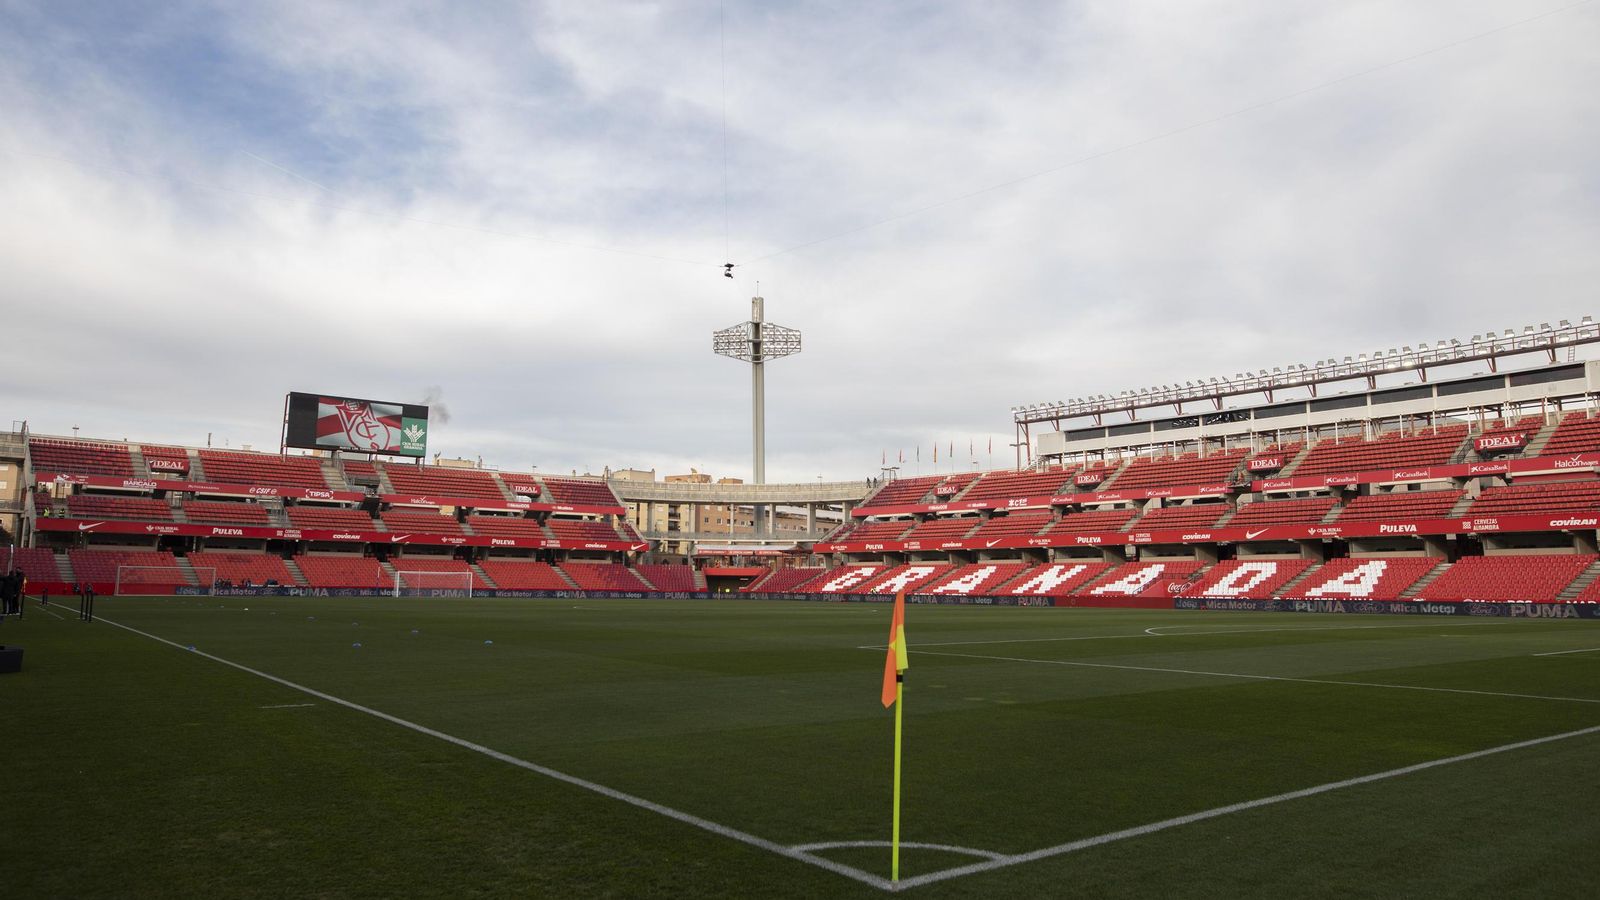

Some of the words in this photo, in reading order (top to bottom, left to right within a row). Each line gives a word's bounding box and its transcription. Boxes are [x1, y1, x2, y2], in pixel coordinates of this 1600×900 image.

[1479, 435, 1520, 447] IDEAL
[153, 460, 184, 469] IDEAL
[1251, 458, 1280, 467] IDEAL
[1077, 474, 1100, 483] IDEAL
[515, 485, 537, 493] IDEAL
[937, 486, 956, 494] IDEAL
[212, 528, 243, 536] PULEVA
[1379, 524, 1417, 533] PULEVA
[491, 538, 515, 546] PULEVA
[1077, 536, 1101, 544] PULEVA
[290, 588, 328, 597] PUMA
[431, 589, 465, 598] PUMA
[911, 596, 938, 604] PUMA
[1018, 597, 1049, 606] PUMA
[1228, 601, 1257, 610] Motor
[1390, 604, 1418, 613] Mica
[1510, 603, 1580, 618] PUMA
